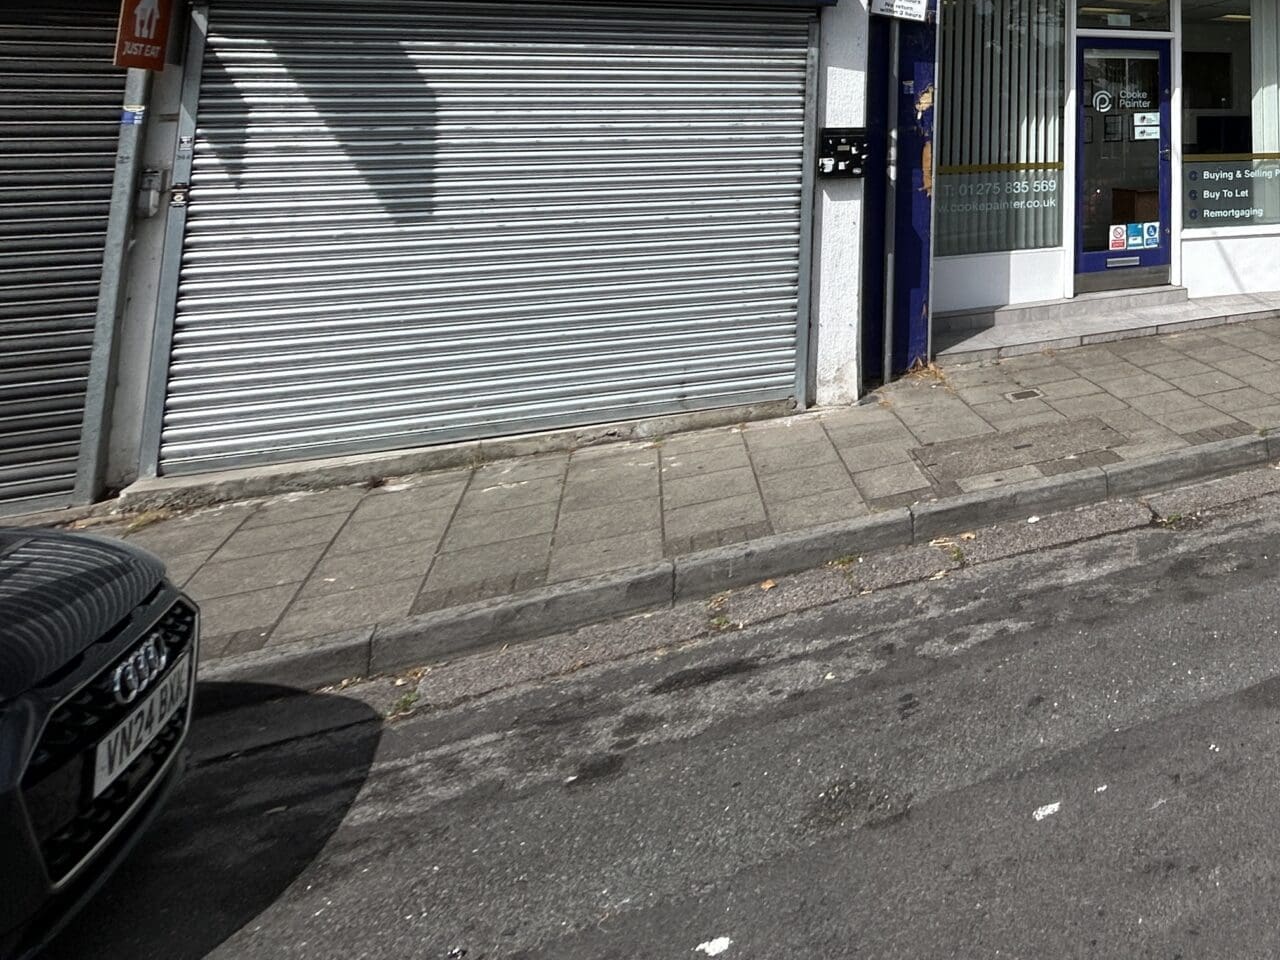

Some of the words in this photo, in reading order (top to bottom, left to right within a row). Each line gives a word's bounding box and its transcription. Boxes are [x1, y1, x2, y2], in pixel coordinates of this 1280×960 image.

[122, 41, 144, 56] JUST
[144, 43, 161, 57] EAT
[1120, 90, 1148, 99] Cooke
[1120, 99, 1151, 108] Painter
[1203, 170, 1233, 180] Buying
[1236, 170, 1242, 178] &
[1244, 169, 1273, 179] Selling
[959, 182, 1001, 196] 01275
[1005, 181, 1029, 194] 835
[1033, 179, 1057, 192] 569
[1203, 190, 1220, 200] Buy
[1222, 189, 1233, 198] To
[1235, 189, 1248, 197] Let
[1203, 208, 1264, 218] Remortgaging
[107, 698, 154, 776] VN24
